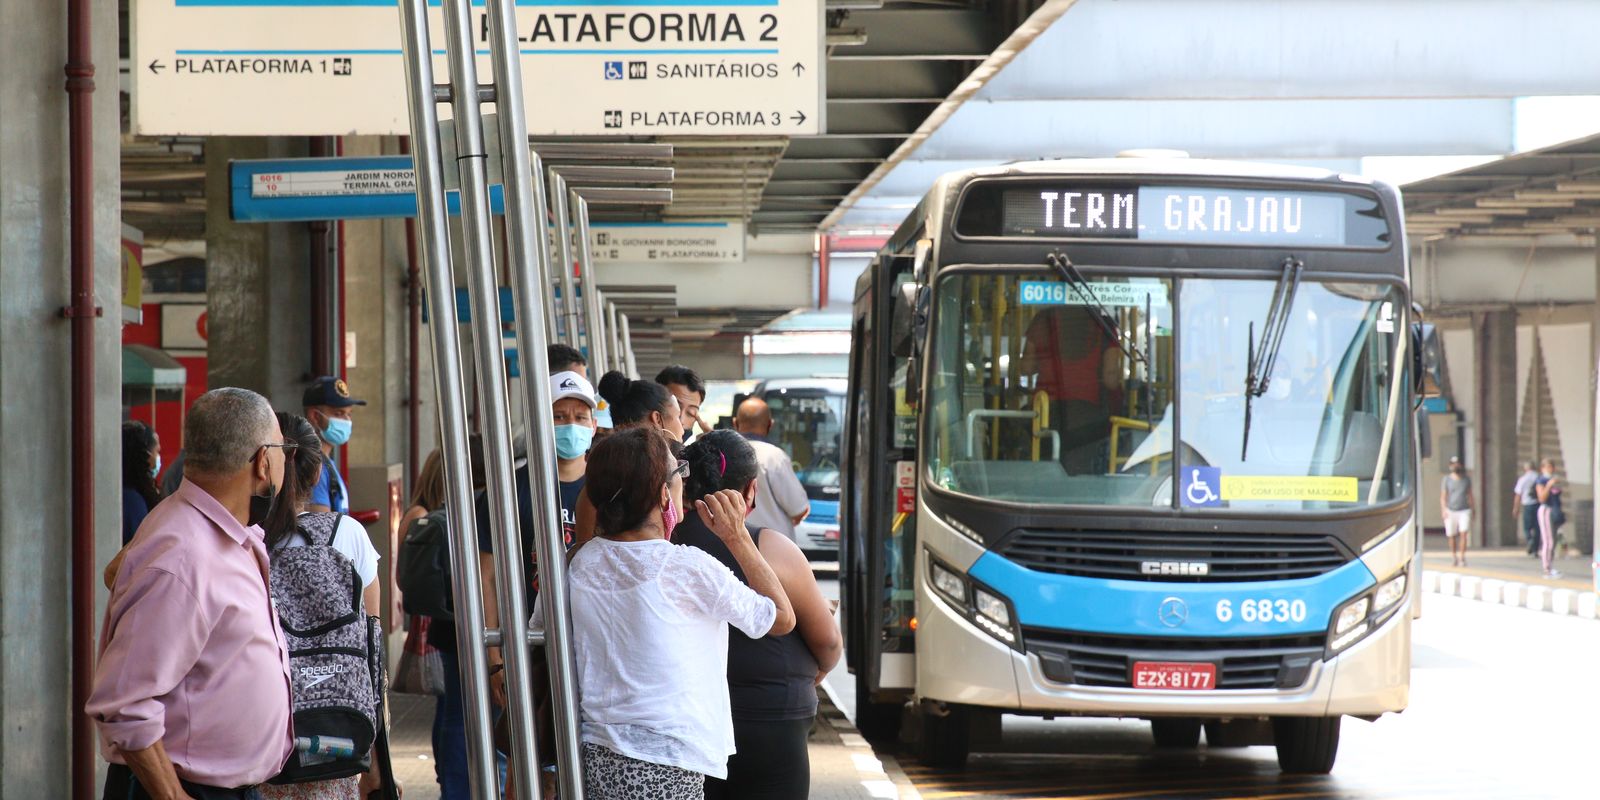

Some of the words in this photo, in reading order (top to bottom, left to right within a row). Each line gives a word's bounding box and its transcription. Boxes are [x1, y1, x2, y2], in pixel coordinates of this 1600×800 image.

[759, 14, 779, 42] 2
[175, 59, 313, 74] PLATAFORMA
[319, 60, 328, 74] 1
[656, 59, 779, 79] SANITÁRIOS
[630, 111, 765, 127] PLATAFORMA
[771, 111, 782, 126] 3
[259, 174, 283, 183] 6016
[344, 172, 381, 181] JARDIM
[266, 184, 278, 192] 10
[343, 181, 391, 190] TERMINAL
[394, 180, 415, 189] GRA
[1041, 192, 1147, 230] TERM.
[1164, 194, 1303, 234] GRAJAU
[660, 250, 720, 258] PLATAFORMA
[1023, 284, 1064, 302] 6016
[1101, 294, 1135, 304] Belmira
[1251, 487, 1273, 496] COM
[1274, 487, 1293, 496] USO
[1294, 487, 1305, 496] DE
[1141, 561, 1209, 576] CAIO
[1215, 598, 1233, 623] 6
[1240, 598, 1307, 623] 6830
[300, 662, 343, 679] speedo
